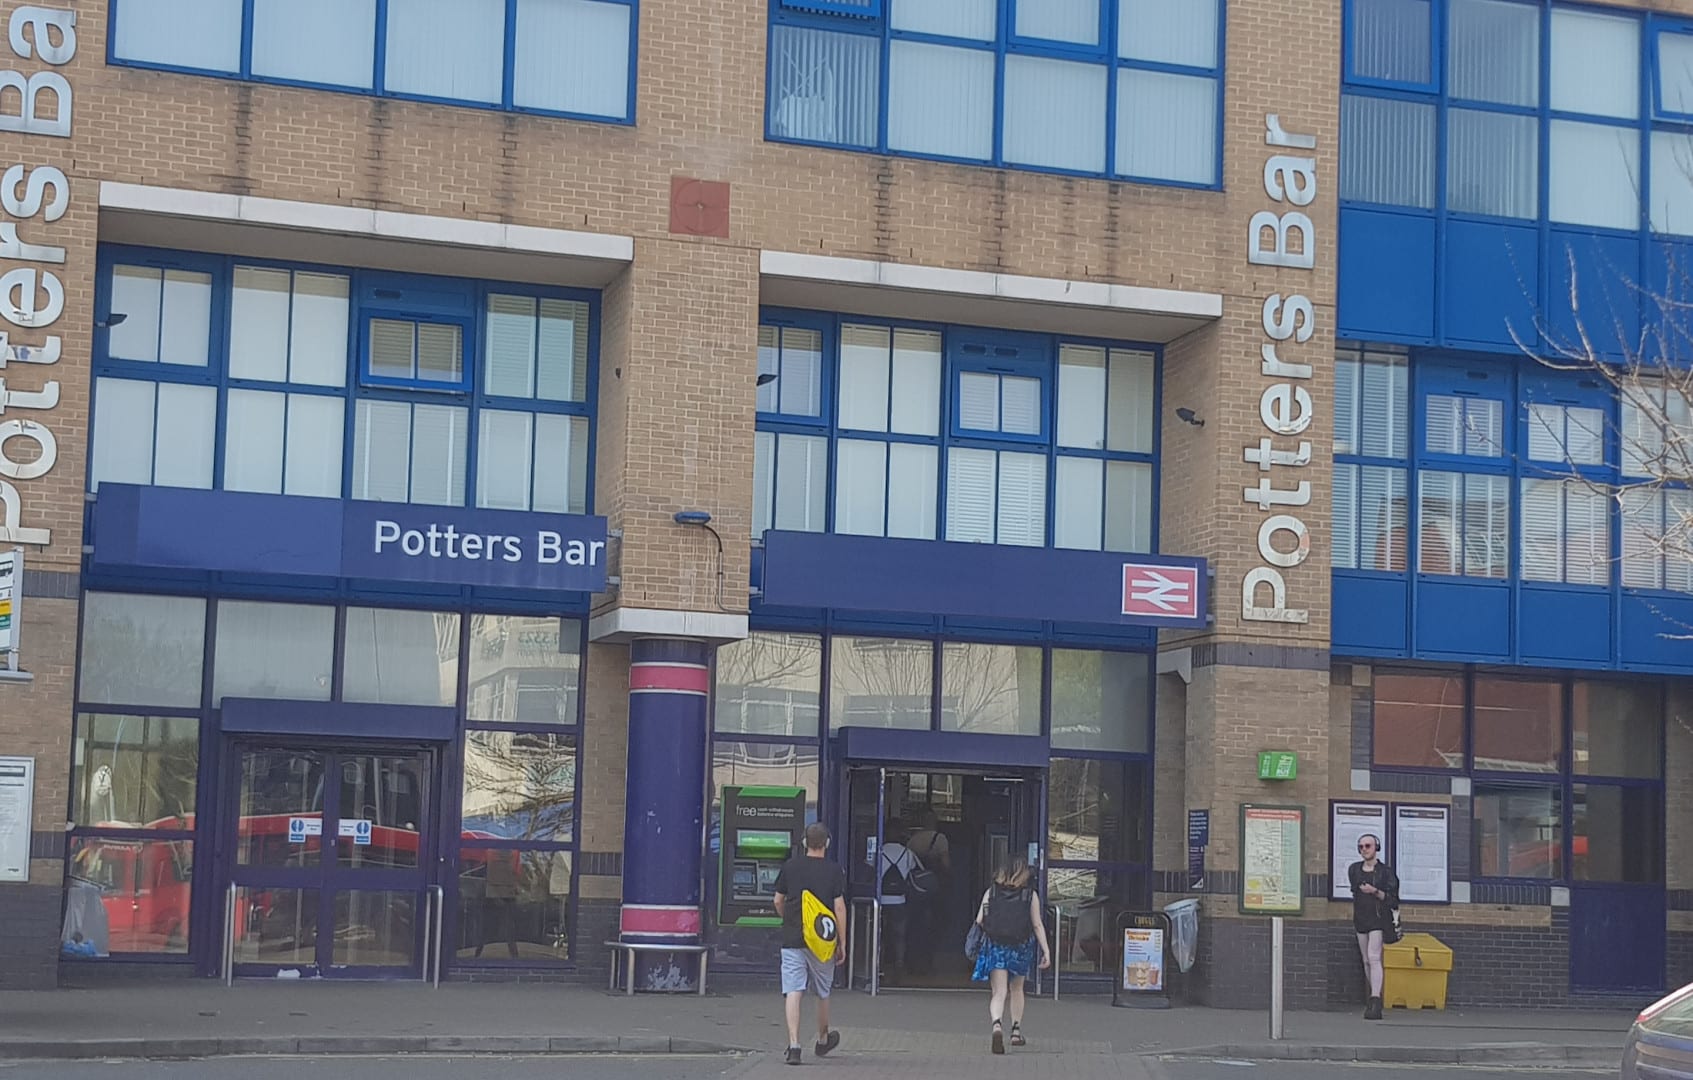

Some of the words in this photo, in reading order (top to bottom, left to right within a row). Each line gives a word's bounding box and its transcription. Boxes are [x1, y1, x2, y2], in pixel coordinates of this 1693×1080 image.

[0, 5, 77, 138] Ba
[1248, 112, 1317, 268] Bar
[1241, 293, 1315, 625] Potters
[374, 520, 523, 562] Potters
[537, 531, 605, 566] Bar
[735, 804, 757, 817] free
